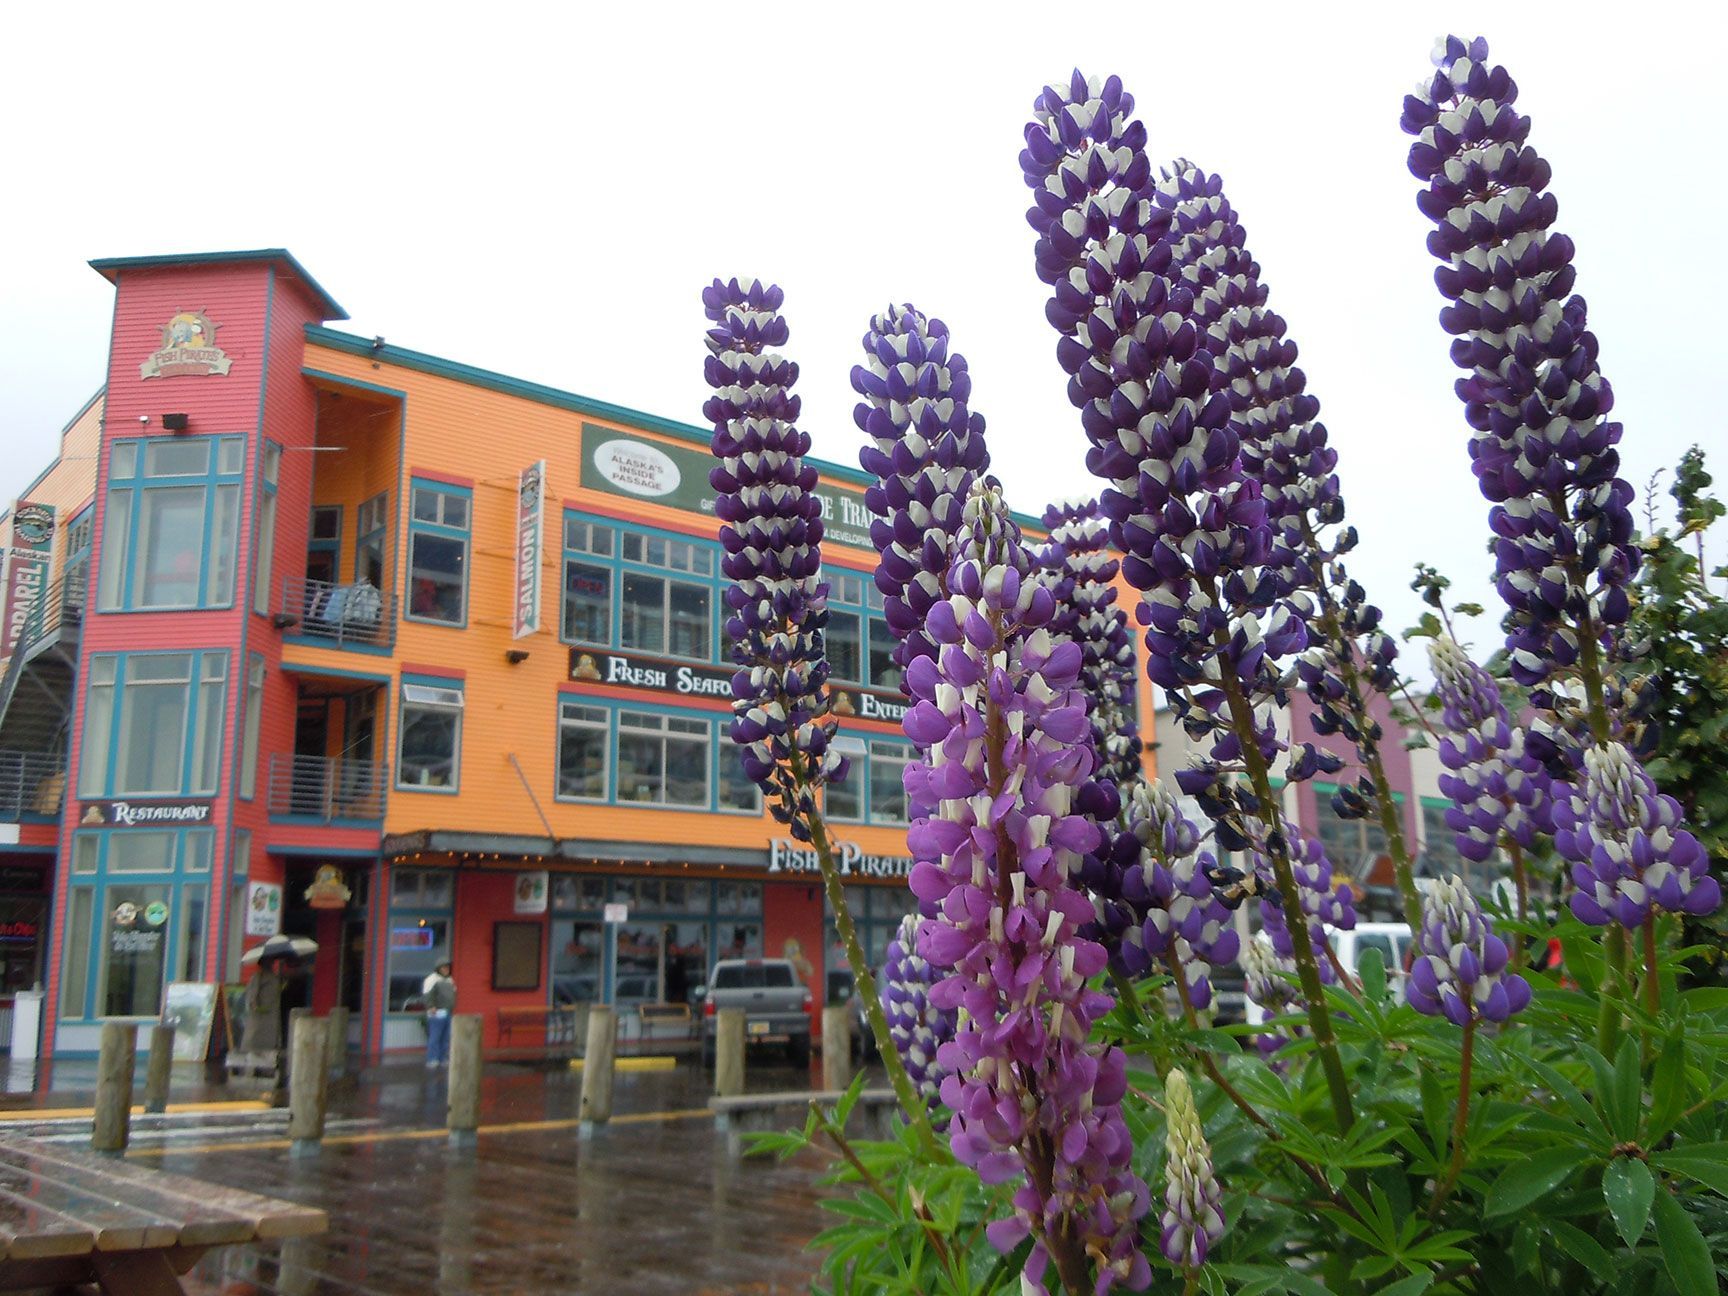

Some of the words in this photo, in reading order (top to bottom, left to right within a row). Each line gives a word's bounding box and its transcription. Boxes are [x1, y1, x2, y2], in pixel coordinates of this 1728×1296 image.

[611, 454, 664, 474] ALASKA'S
[619, 465, 655, 481] INSIDE
[611, 472, 662, 491] PASSAGE
[519, 527, 536, 622] SALMON
[607, 656, 667, 687] FRESH
[112, 801, 209, 825] RESTAURANT
